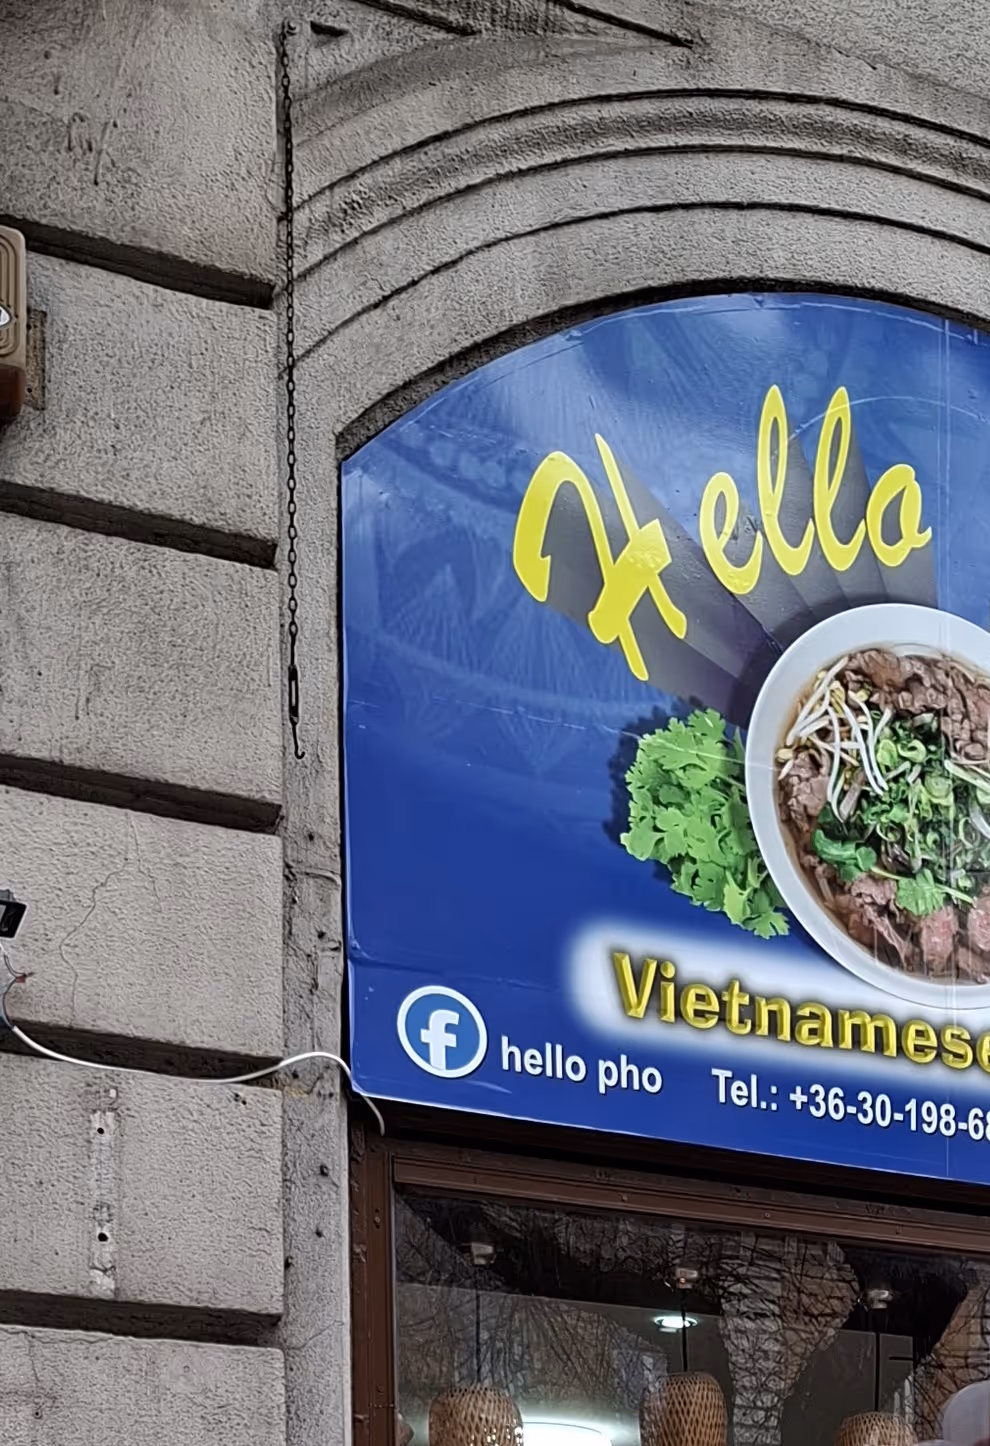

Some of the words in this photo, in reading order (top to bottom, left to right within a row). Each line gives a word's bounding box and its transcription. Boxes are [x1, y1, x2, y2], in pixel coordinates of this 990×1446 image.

[513, 385, 932, 681] Hello
[502, 1035, 587, 1082] hello
[599, 1054, 663, 1094] pho
[711, 1068, 778, 1111] Tel.:
